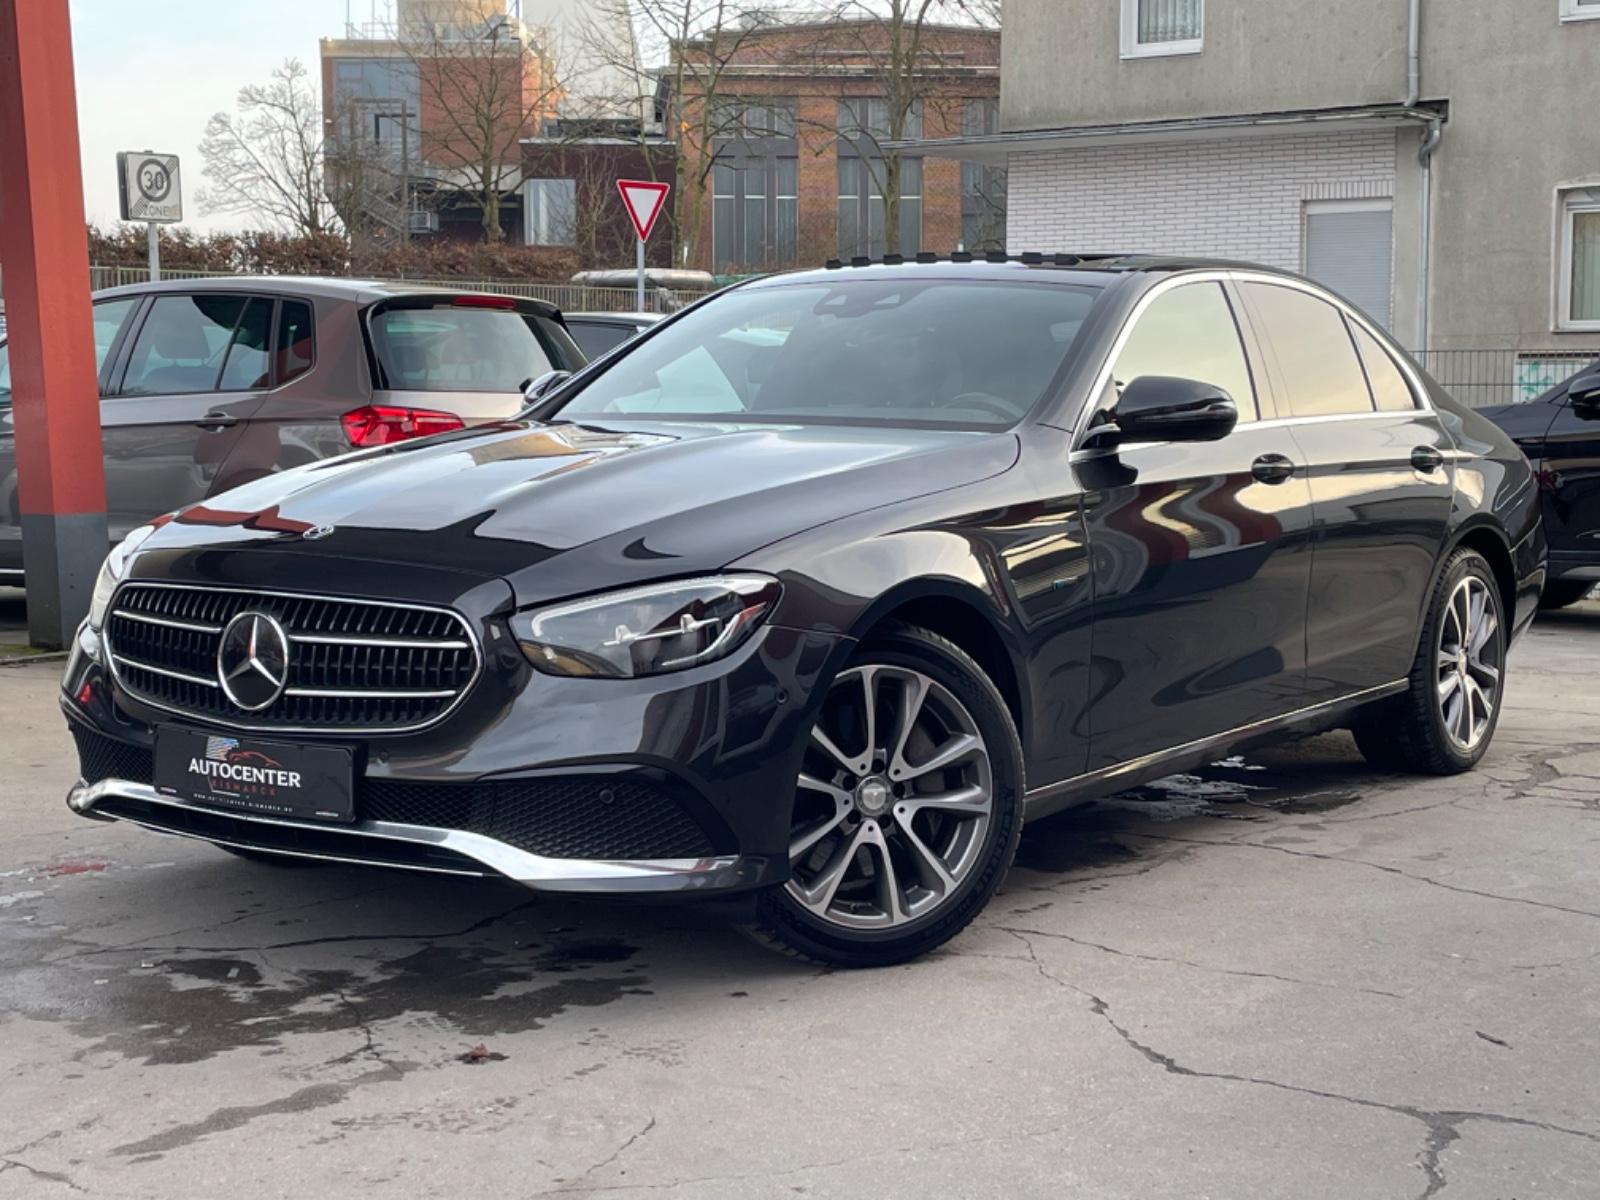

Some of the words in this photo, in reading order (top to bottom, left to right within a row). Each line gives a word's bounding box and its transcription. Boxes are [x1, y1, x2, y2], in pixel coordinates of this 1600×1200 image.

[144, 170, 165, 191] 30
[143, 204, 169, 217] ZONE
[188, 757, 301, 788] AUTOCENTER
[211, 780, 277, 796] BISMARCK
